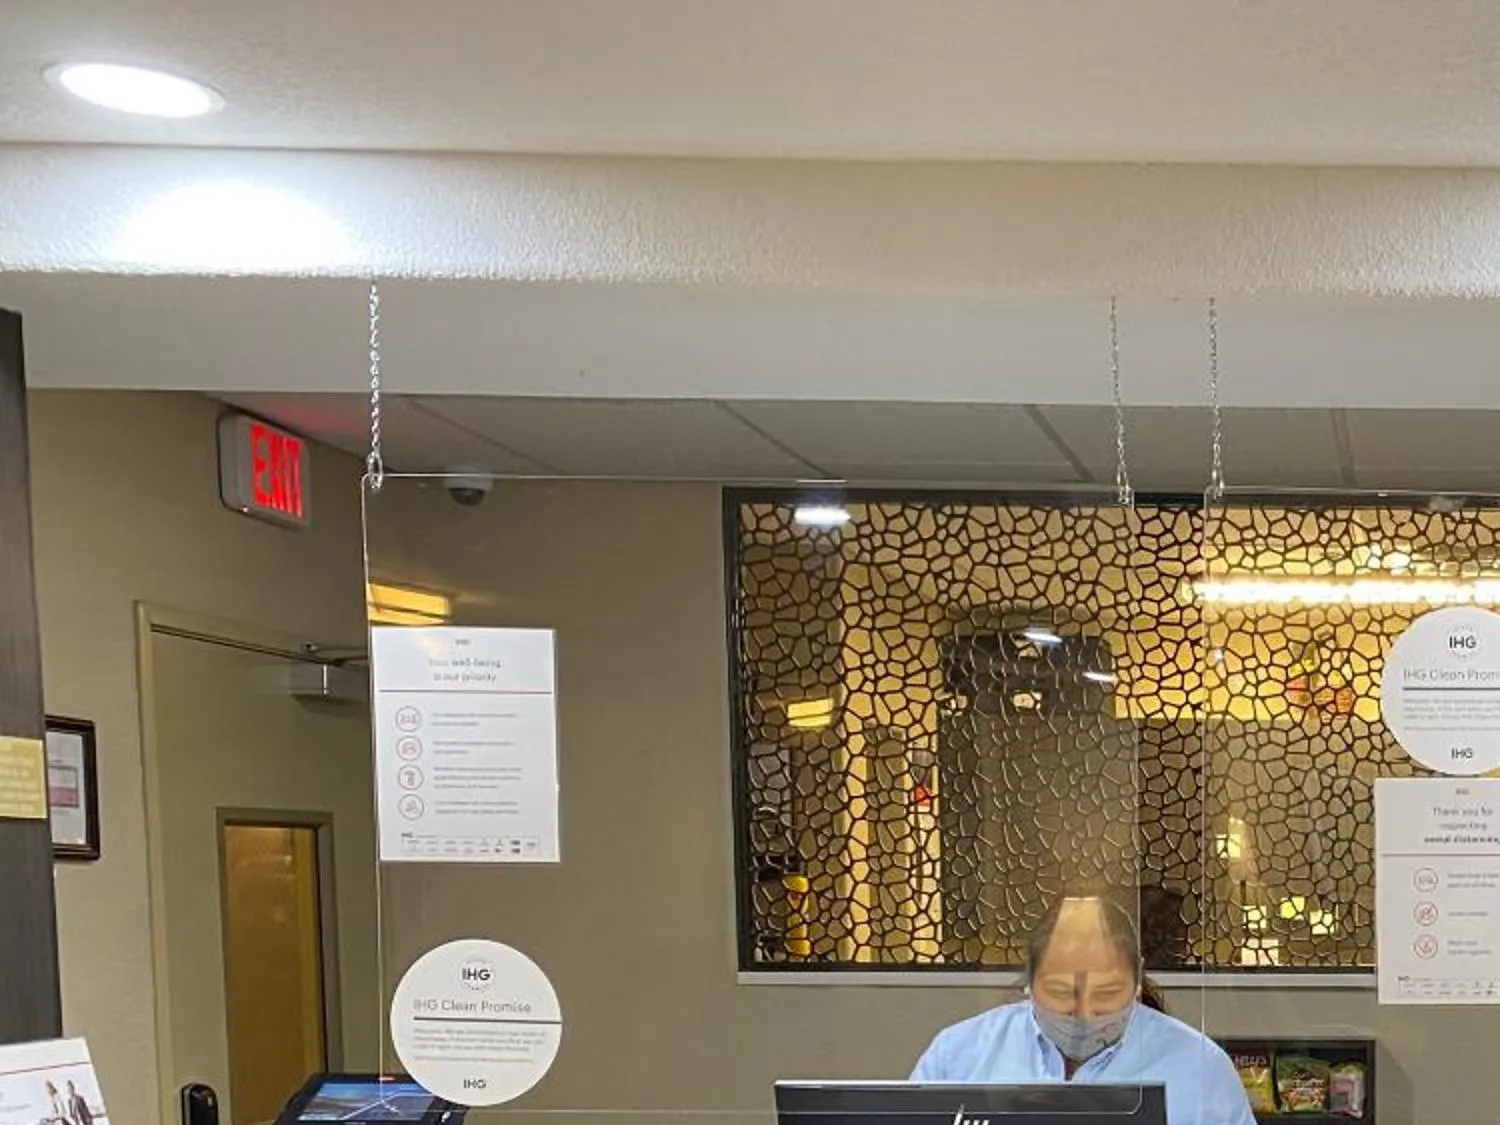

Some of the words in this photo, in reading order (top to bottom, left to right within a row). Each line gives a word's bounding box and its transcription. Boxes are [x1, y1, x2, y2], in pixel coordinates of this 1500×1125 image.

[250, 423, 304, 519] EXIT
[1449, 636, 1477, 649] IHG
[1403, 669, 1426, 681] IHG
[1429, 669, 1465, 681] Clean
[1451, 748, 1474, 759] IHG
[462, 968, 492, 981] IHG
[413, 999, 438, 1011] IHG
[441, 1000, 477, 1012] Clean
[481, 1001, 532, 1014] Promise
[463, 1079, 487, 1090] IHG
